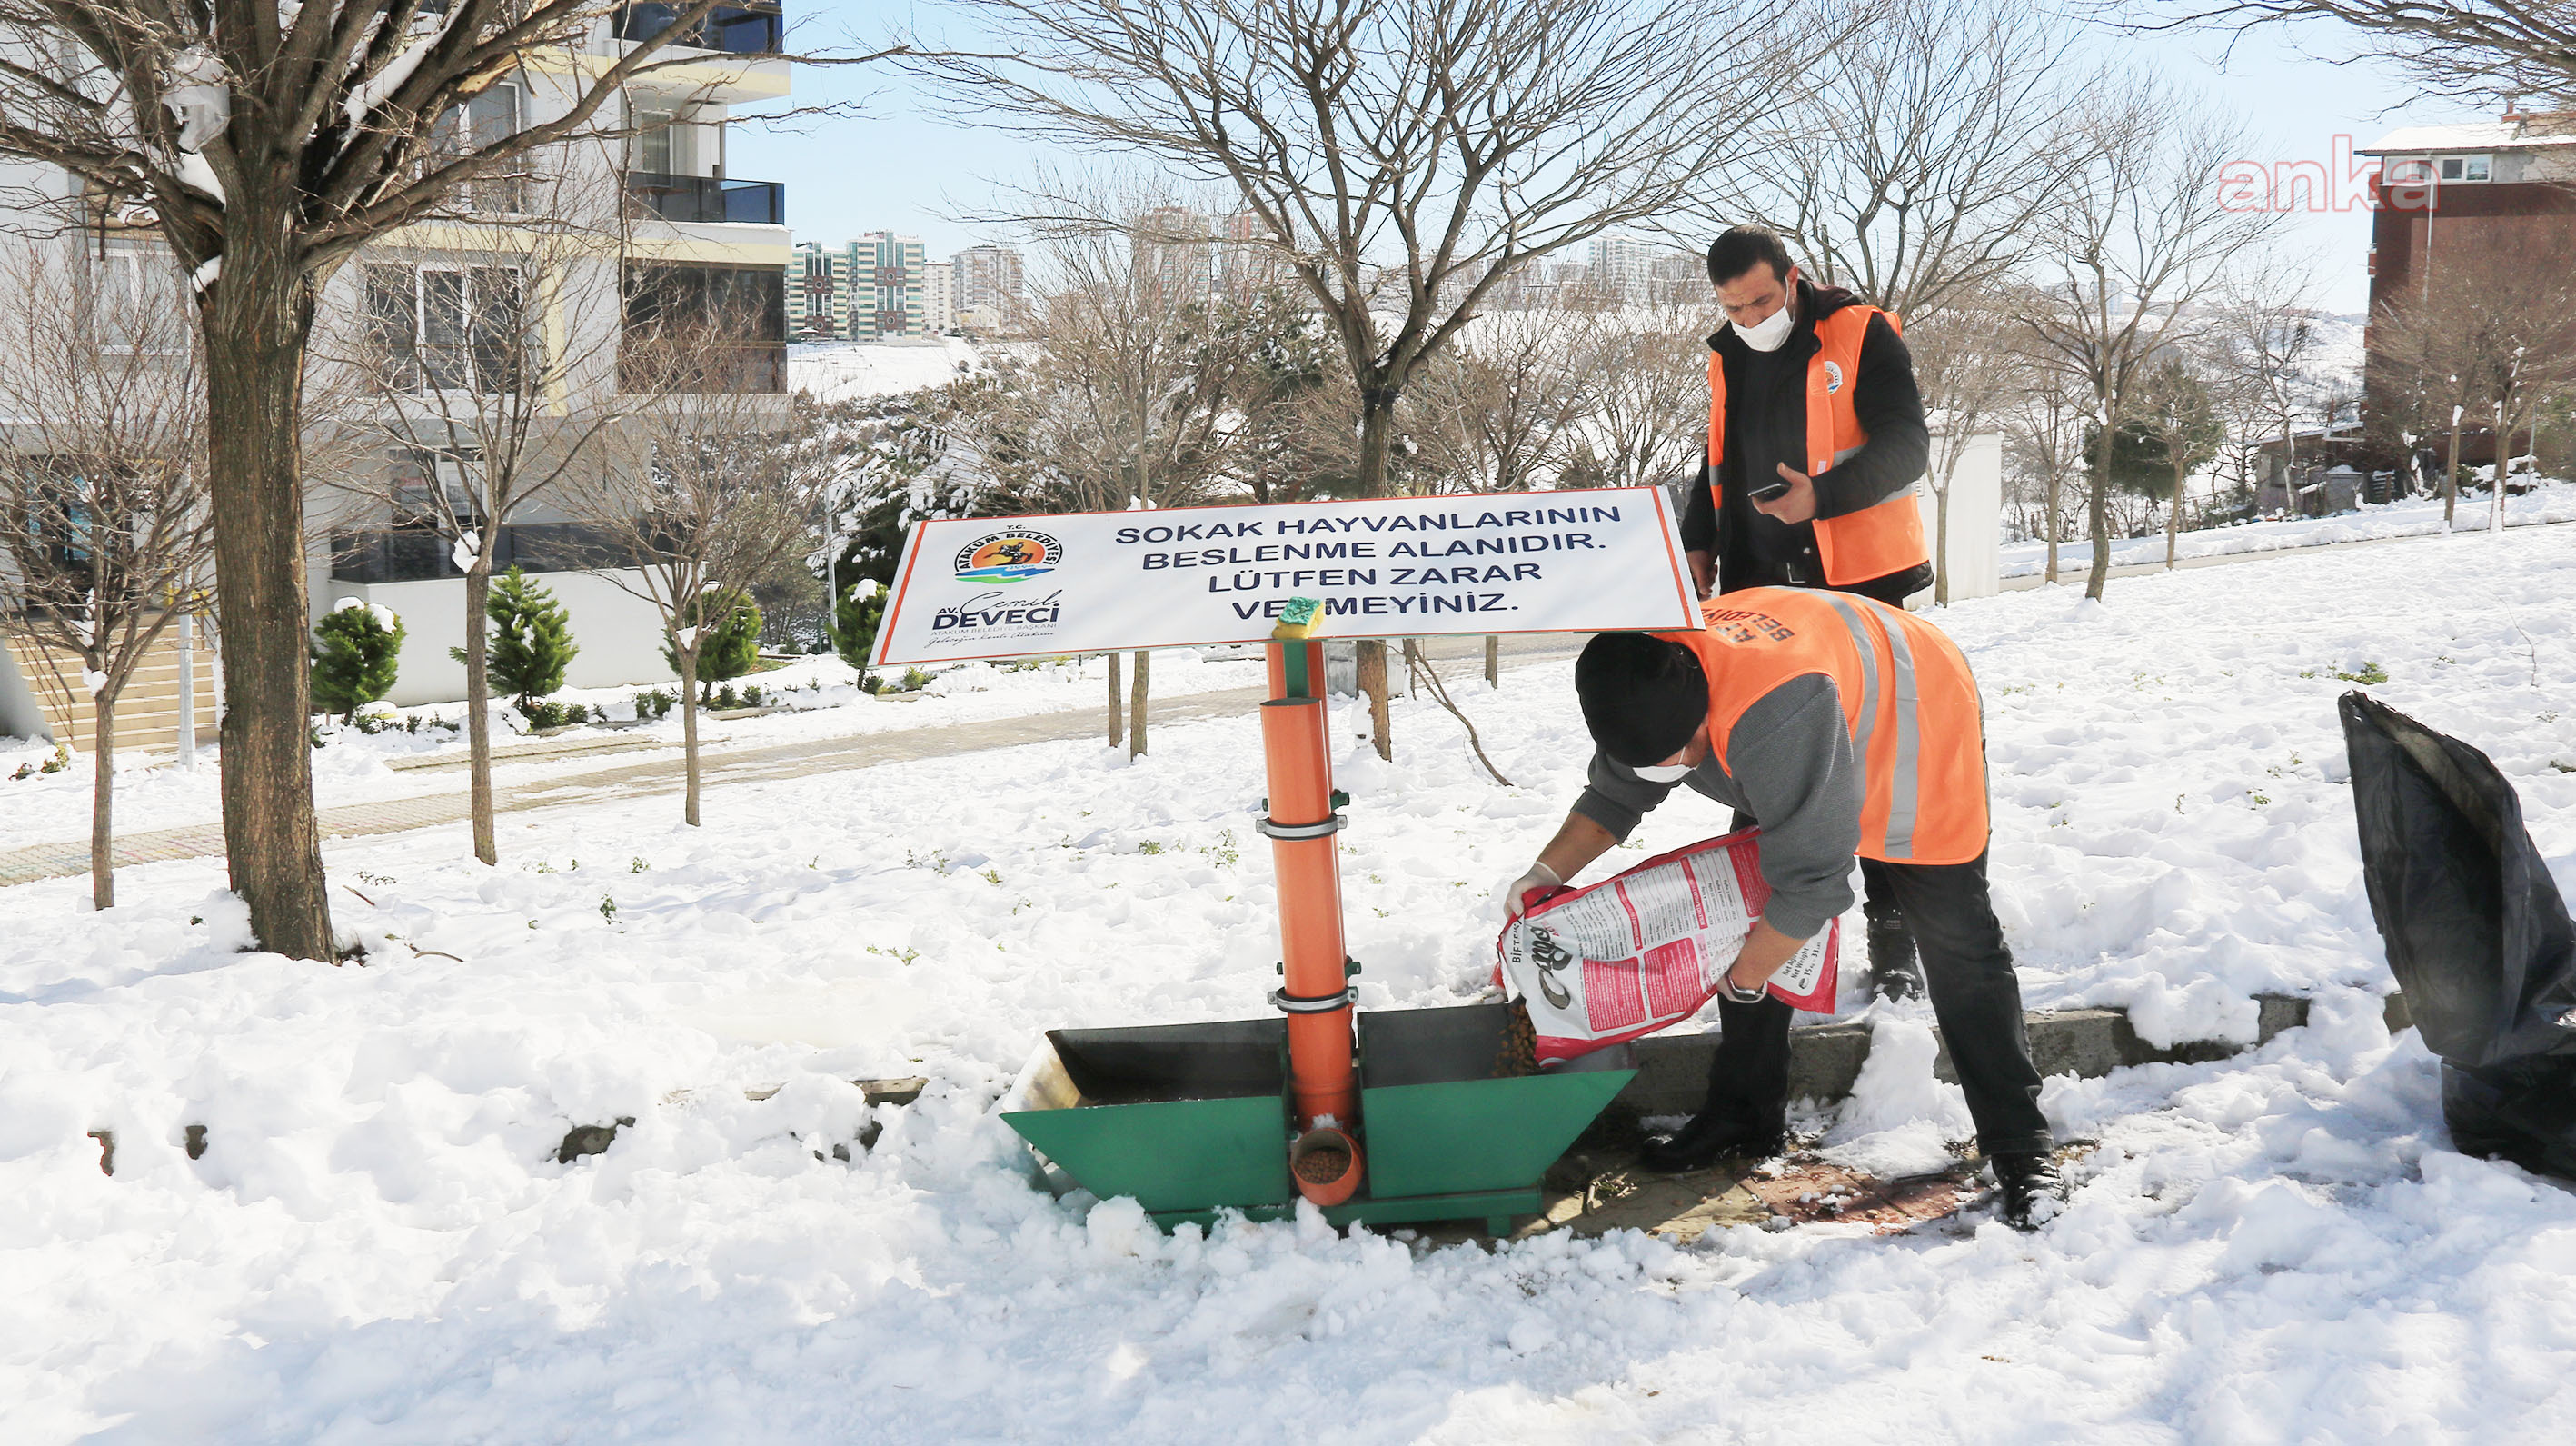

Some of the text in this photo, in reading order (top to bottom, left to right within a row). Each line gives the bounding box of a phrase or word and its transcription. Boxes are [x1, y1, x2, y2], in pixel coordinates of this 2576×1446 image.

[1115, 506, 1621, 544] SOKAK HAYVANLARININ
[959, 535, 1000, 570] ATAKUM
[1142, 533, 1606, 570] BESLENME ALANIDIR.
[1208, 563, 1542, 593] LÜTFEN ZARAR
[932, 603, 1060, 631] DEVECİ
[1232, 591, 1518, 620] VEMEYİNİZ.
[1795, 947, 1809, 969] Weight
